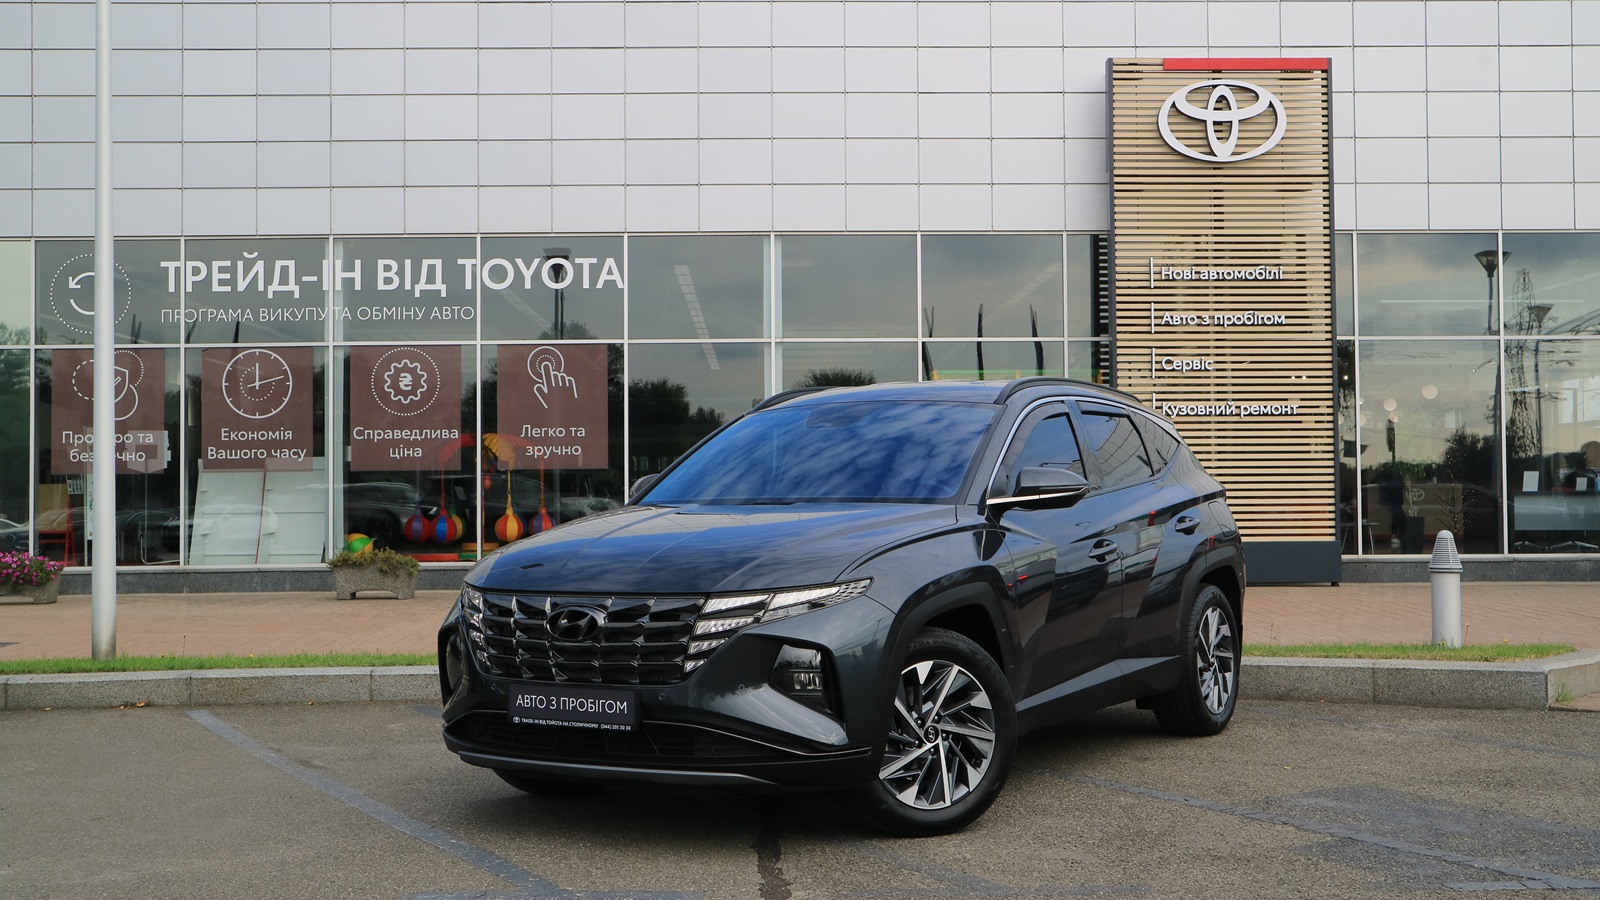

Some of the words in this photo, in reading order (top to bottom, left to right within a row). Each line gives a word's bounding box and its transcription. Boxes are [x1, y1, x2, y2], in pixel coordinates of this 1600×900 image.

[160, 251, 362, 299] ТРЕЙД-ІН
[376, 258, 447, 298] ВІД
[457, 257, 625, 291] TOYOTA
[1161, 266, 1195, 280] Нові
[1199, 265, 1284, 280] автомобілі
[161, 307, 254, 323] ПРОГРАМА
[259, 306, 328, 322] ВИКУПУ
[332, 306, 352, 321] ТА
[357, 305, 427, 321] ОБМІНУ
[430, 305, 475, 321] АВТО
[1161, 311, 1198, 325] Авто
[1201, 315, 1210, 325] з
[1214, 310, 1286, 328] пробігом
[1161, 356, 1214, 374] Сервіс
[1162, 401, 1236, 418] Кузовний
[1240, 403, 1299, 418] ремонт
[62, 430, 134, 447] Проро
[137, 432, 154, 444] та
[221, 427, 293, 441] Економія
[353, 426, 459, 442] Справедлива
[520, 424, 566, 438] Легко
[569, 426, 586, 437] та
[207, 446, 267, 460] Вашого
[271, 447, 307, 462] часу
[389, 444, 422, 459] ціна
[525, 445, 582, 459] зручно
[516, 694, 547, 709] АВТО
[549, 696, 557, 710] З
[560, 697, 627, 714] ПРОБІГОМ
[569, 721, 599, 729] СТОЛИЧНОМУ
